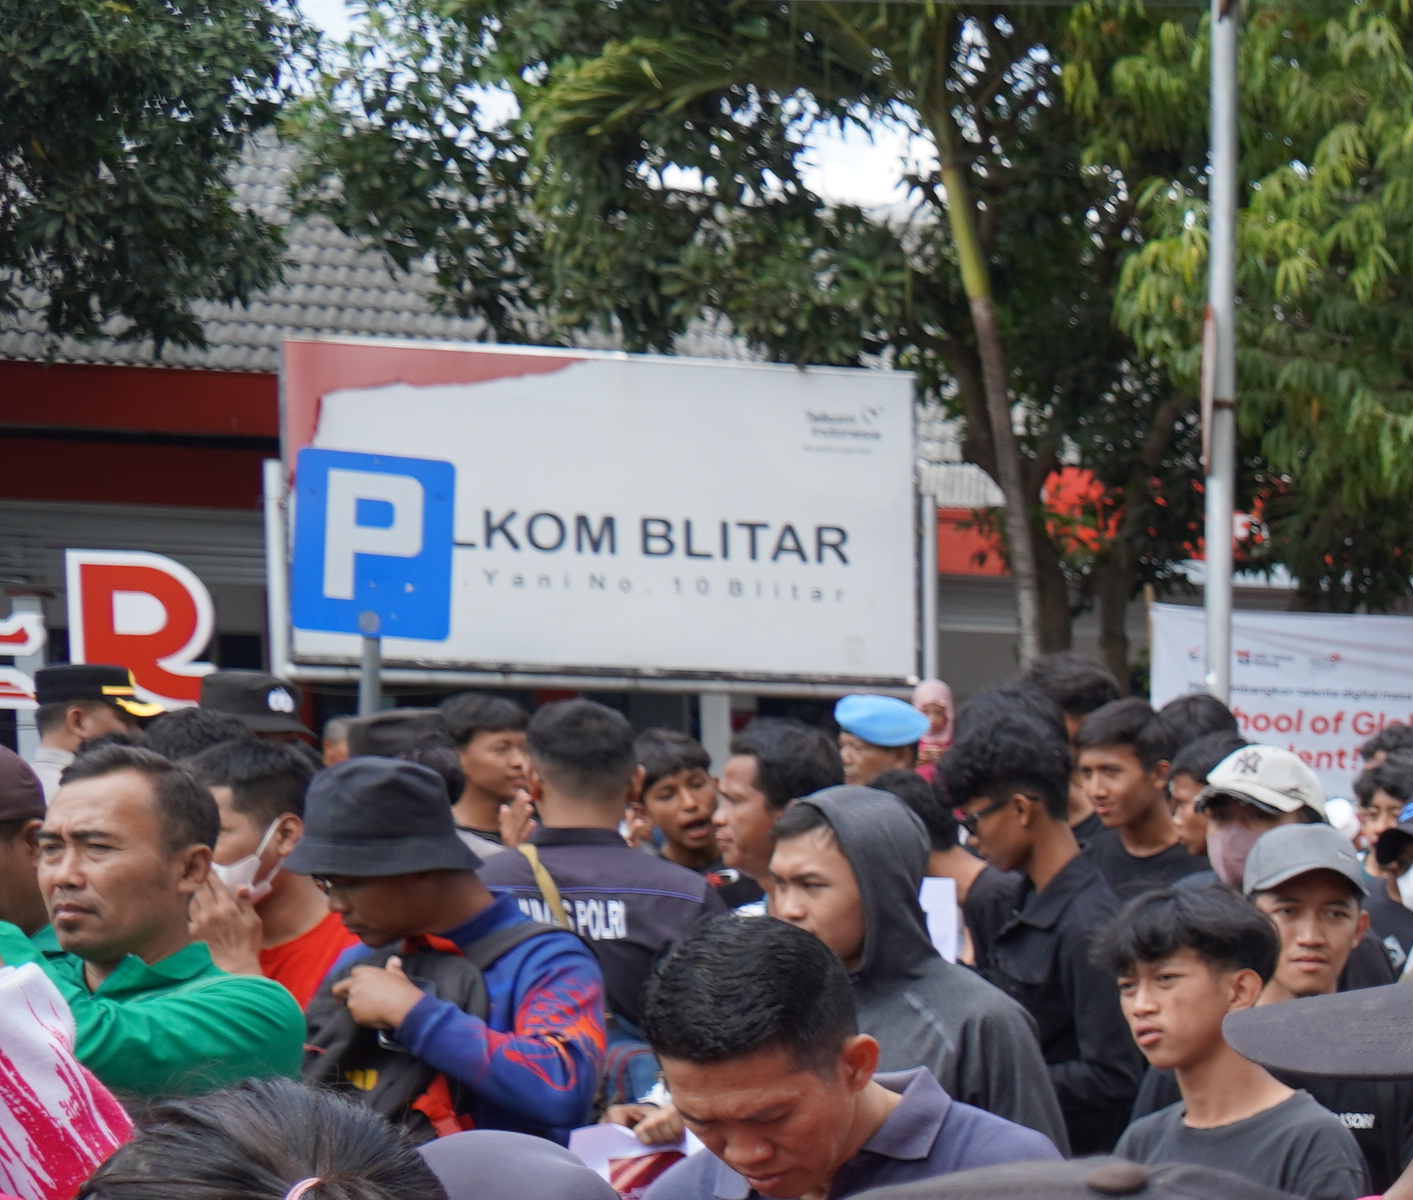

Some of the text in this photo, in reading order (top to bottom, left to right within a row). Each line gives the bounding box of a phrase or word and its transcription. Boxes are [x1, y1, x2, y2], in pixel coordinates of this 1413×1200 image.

[322, 468, 426, 600] P
[640, 517, 850, 565] BLITAR
[673, 577, 709, 597] 10
[728, 577, 844, 602] Blitar
[1310, 709, 1345, 734] of
[575, 899, 627, 940] POLRI
